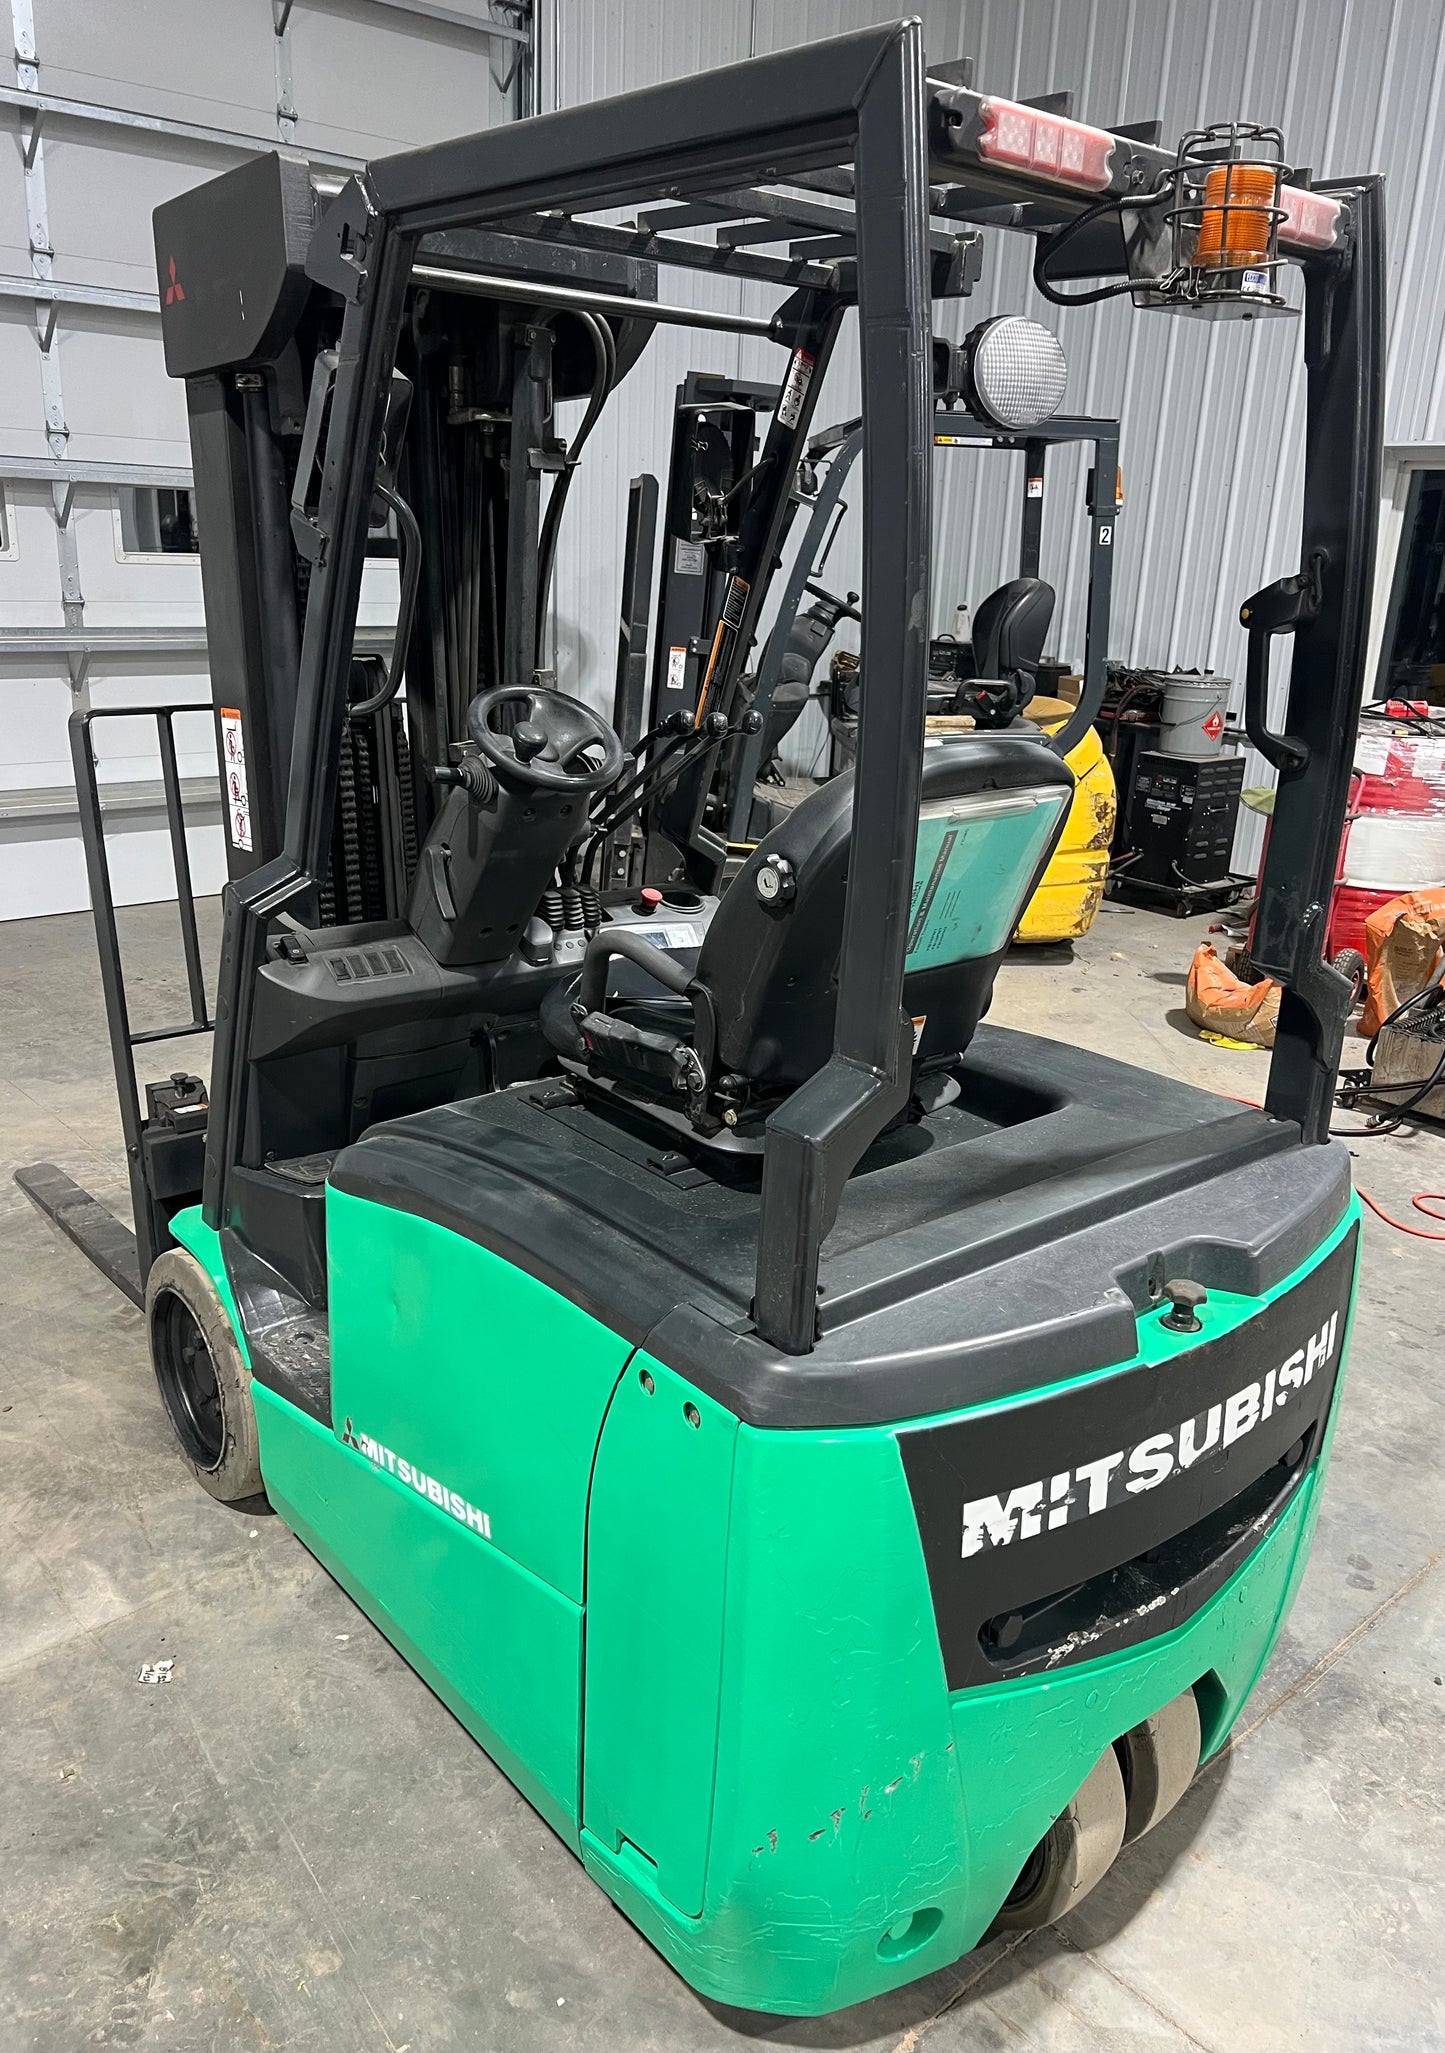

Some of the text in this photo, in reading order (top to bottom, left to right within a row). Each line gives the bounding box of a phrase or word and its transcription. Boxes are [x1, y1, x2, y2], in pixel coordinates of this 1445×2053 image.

[1101, 528, 1110, 543] 2
[906, 917, 922, 952] Operation
[922, 863, 943, 910] Maintenance
[939, 834, 954, 863] Manual
[360, 1432, 492, 1540] MITSUBISHI
[961, 1310, 1338, 1559] MITSUBISHI
